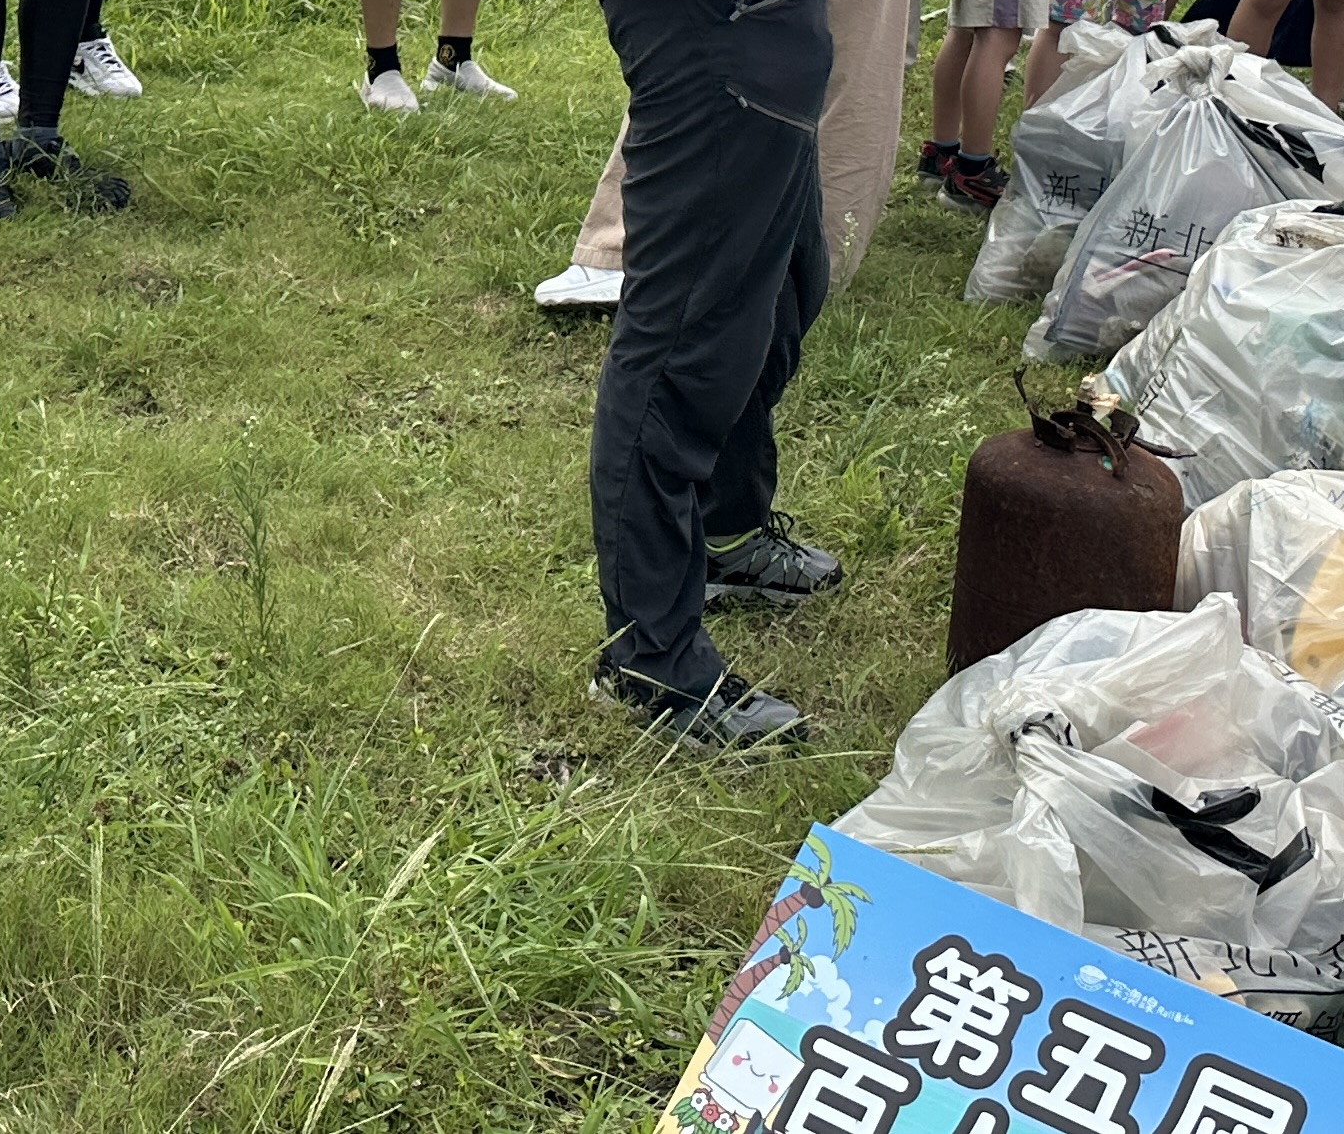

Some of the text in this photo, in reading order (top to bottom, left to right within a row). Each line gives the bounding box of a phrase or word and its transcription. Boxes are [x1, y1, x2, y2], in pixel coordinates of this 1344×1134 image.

[1104, 977, 1158, 1014] 深澳線
[795, 1037, 997, 1134] 百
